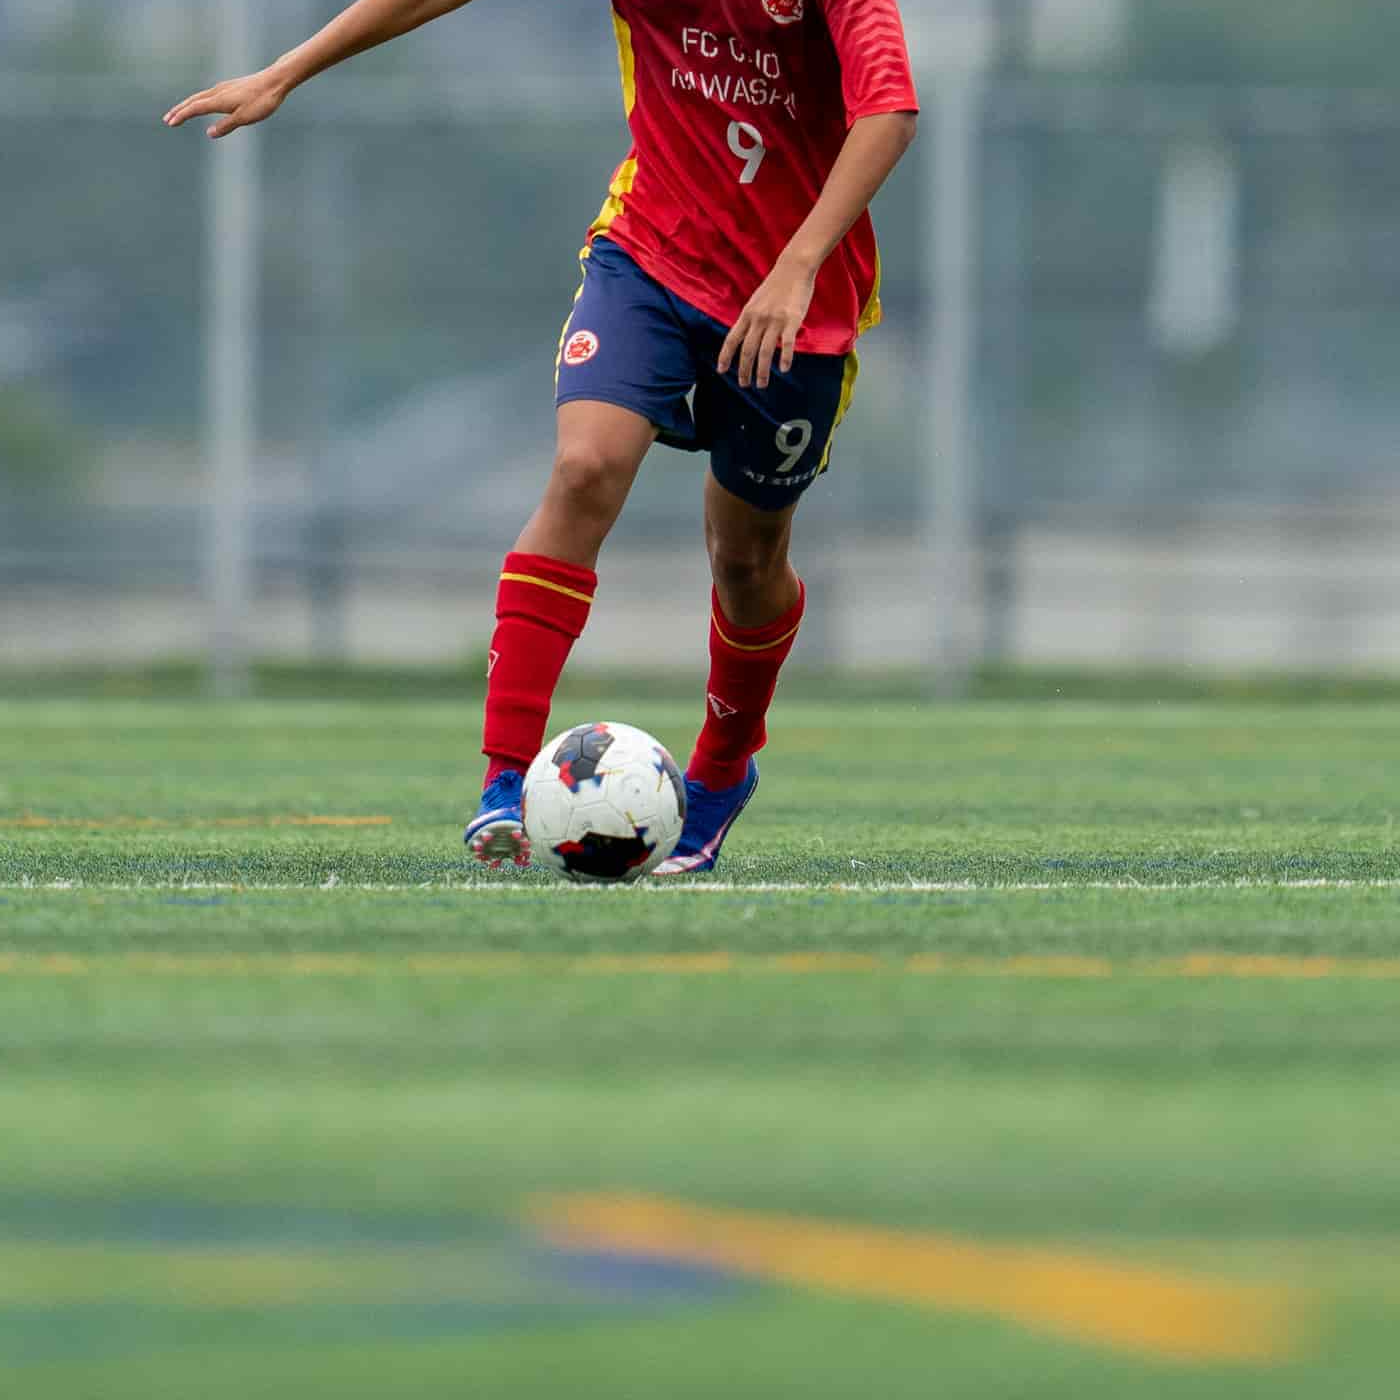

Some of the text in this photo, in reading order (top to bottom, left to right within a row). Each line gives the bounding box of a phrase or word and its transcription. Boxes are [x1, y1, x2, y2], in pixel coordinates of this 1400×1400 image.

[682, 27, 718, 58] FC
[727, 120, 765, 184] 9
[775, 418, 812, 472] 9
